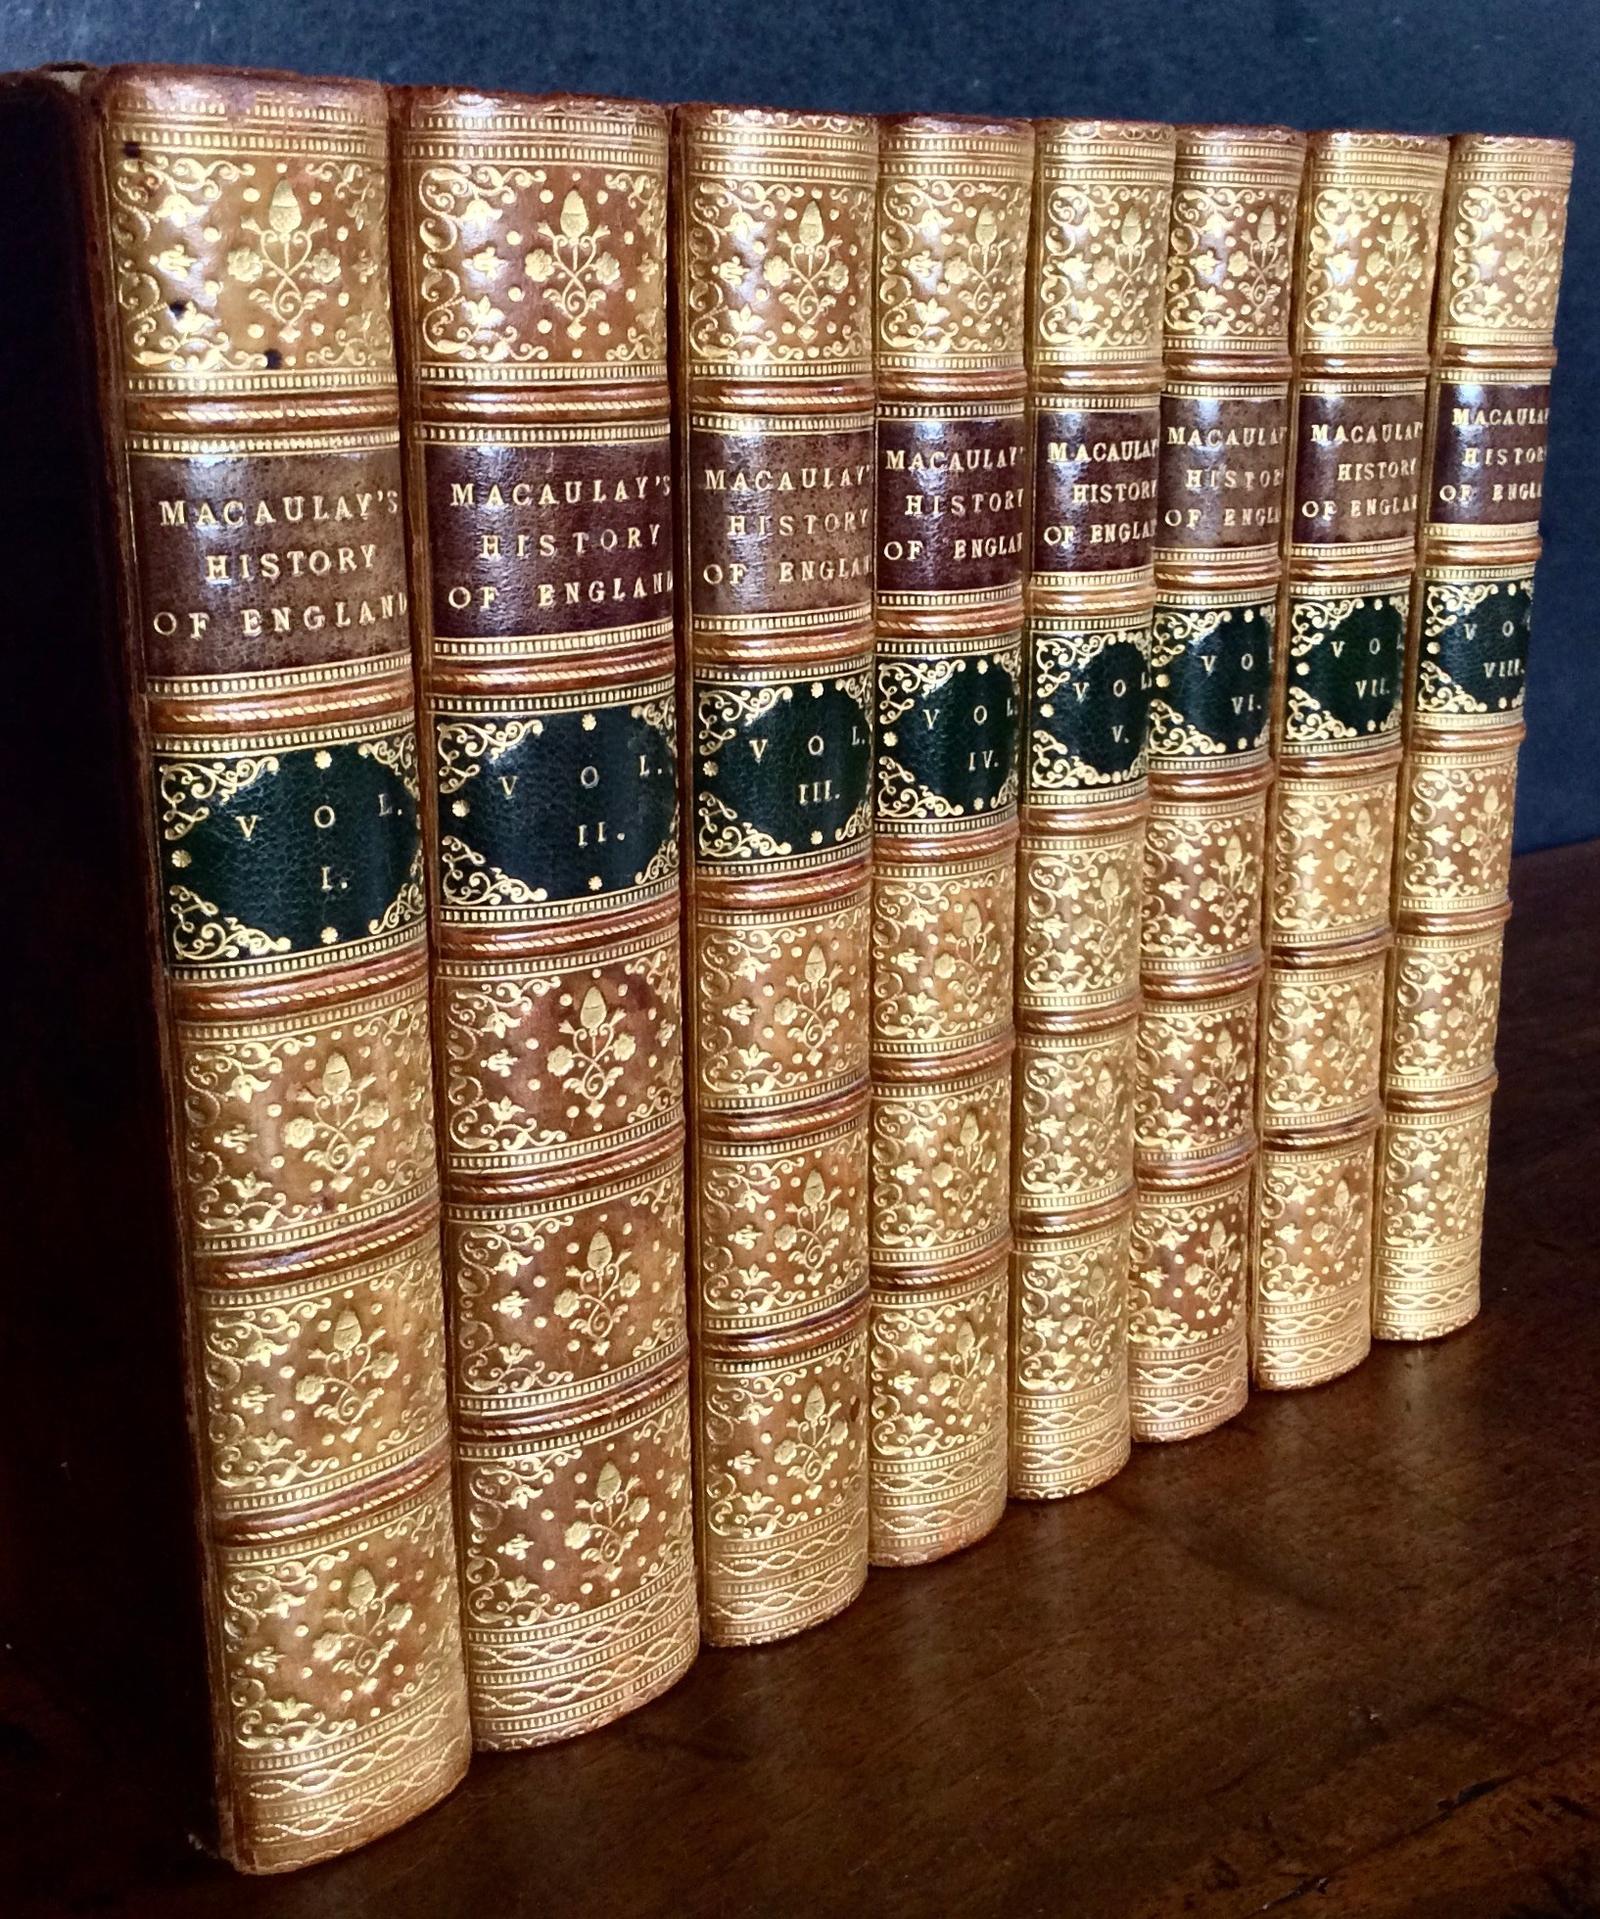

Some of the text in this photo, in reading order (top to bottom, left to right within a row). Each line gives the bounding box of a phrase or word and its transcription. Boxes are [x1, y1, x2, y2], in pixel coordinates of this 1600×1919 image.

[705, 464, 873, 491] MACAULAY'
[450, 475, 671, 506] MACAULAY'S
[1440, 484, 1473, 502] OF
[159, 490, 398, 527] MACAULAY'S
[1165, 509, 1201, 529] OF
[1302, 500, 1337, 520] OF
[727, 508, 868, 536] HISTORY
[480, 524, 660, 561] HISTORY
[1044, 525, 1075, 546] OF
[884, 541, 923, 560] OF
[206, 544, 376, 581] HISTORY
[704, 564, 747, 584] OF
[449, 586, 498, 609] OF
[154, 592, 407, 639] OF ENGLAND
[1231, 694, 1261, 715] VI.
[1111, 725, 1129, 743] V.
[968, 750, 999, 771] IV.
[799, 780, 840, 805] III.
